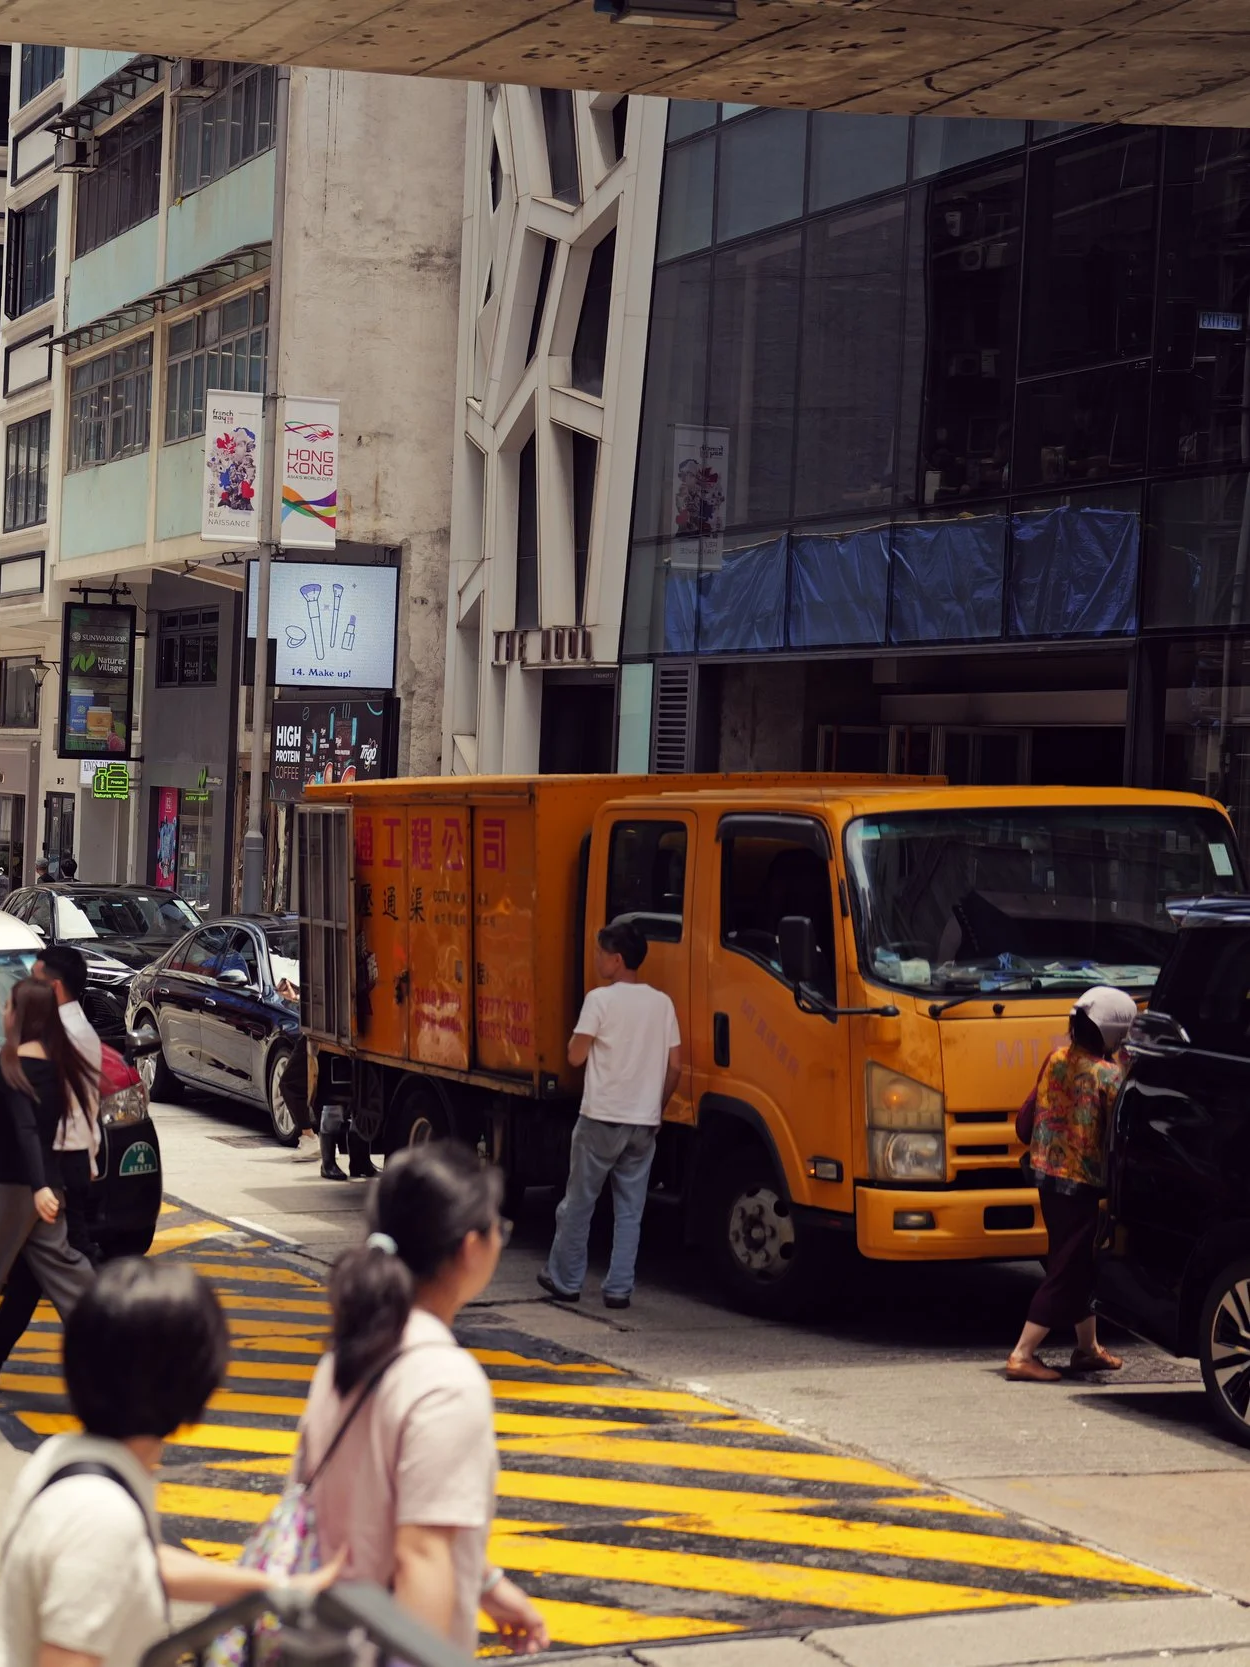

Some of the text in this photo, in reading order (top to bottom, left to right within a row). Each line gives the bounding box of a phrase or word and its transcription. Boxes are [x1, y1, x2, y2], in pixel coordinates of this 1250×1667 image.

[1202, 313, 1220, 327] EXIT
[287, 449, 334, 463] HONG
[287, 463, 334, 476] KONG
[208, 518, 250, 527] NAISSANCE
[82, 634, 127, 643] SUNWARRIOR
[97, 657, 127, 665] Natures
[97, 664, 123, 674] Village
[291, 668, 351, 679] 14. Make up!
[276, 725, 302, 748] HIGH
[275, 749, 301, 763] PROTEIN
[274, 765, 299, 780] COFFEE
[137, 1152, 145, 1164] 4
